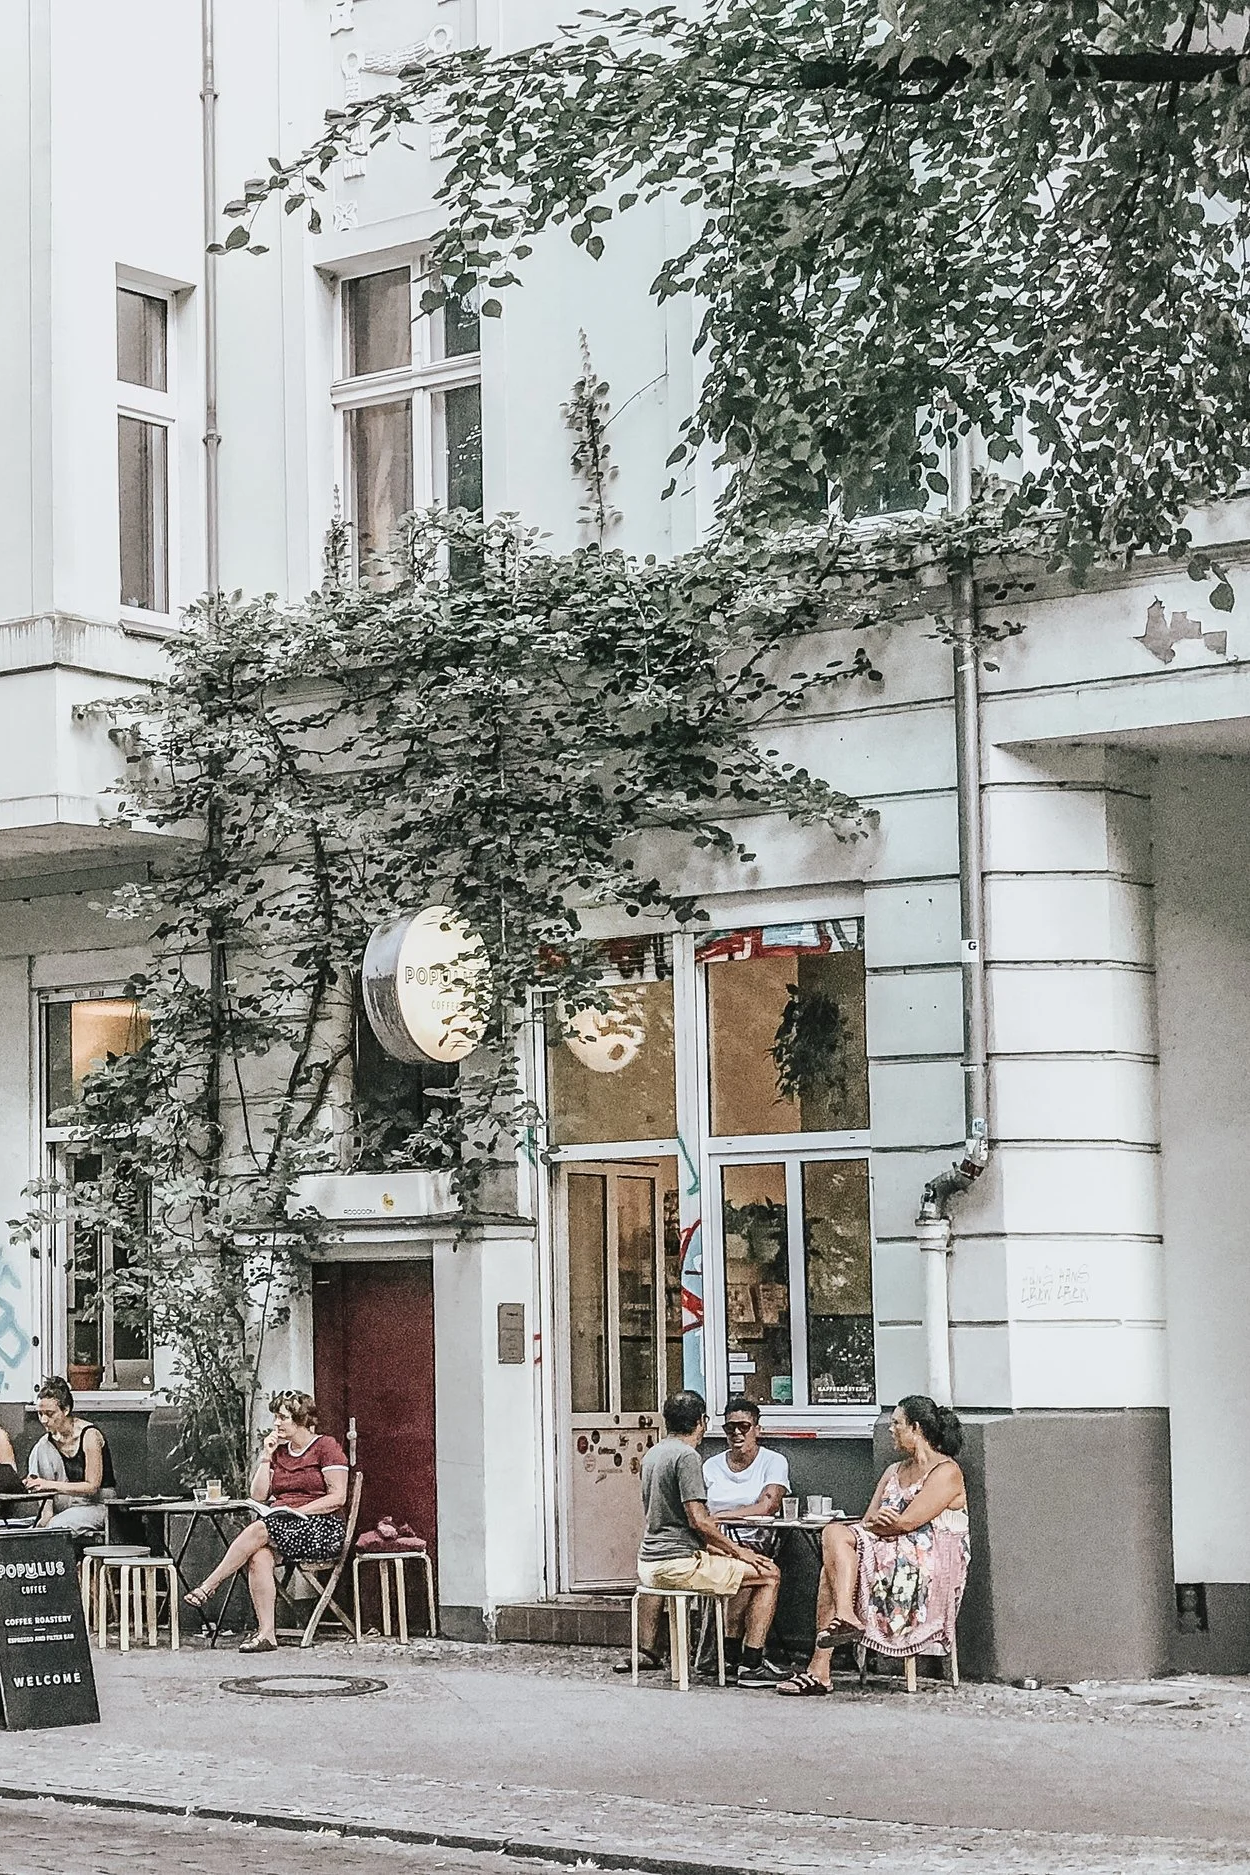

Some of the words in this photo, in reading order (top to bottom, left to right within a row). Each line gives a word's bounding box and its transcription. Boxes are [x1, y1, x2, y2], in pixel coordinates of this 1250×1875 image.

[967, 940, 978, 951] G
[21, 1584, 47, 1595] COFFEE
[4, 1617, 33, 1627] COFFEE
[34, 1614, 72, 1624] ROASTERY
[13, 1672, 82, 1688] WELCOME
